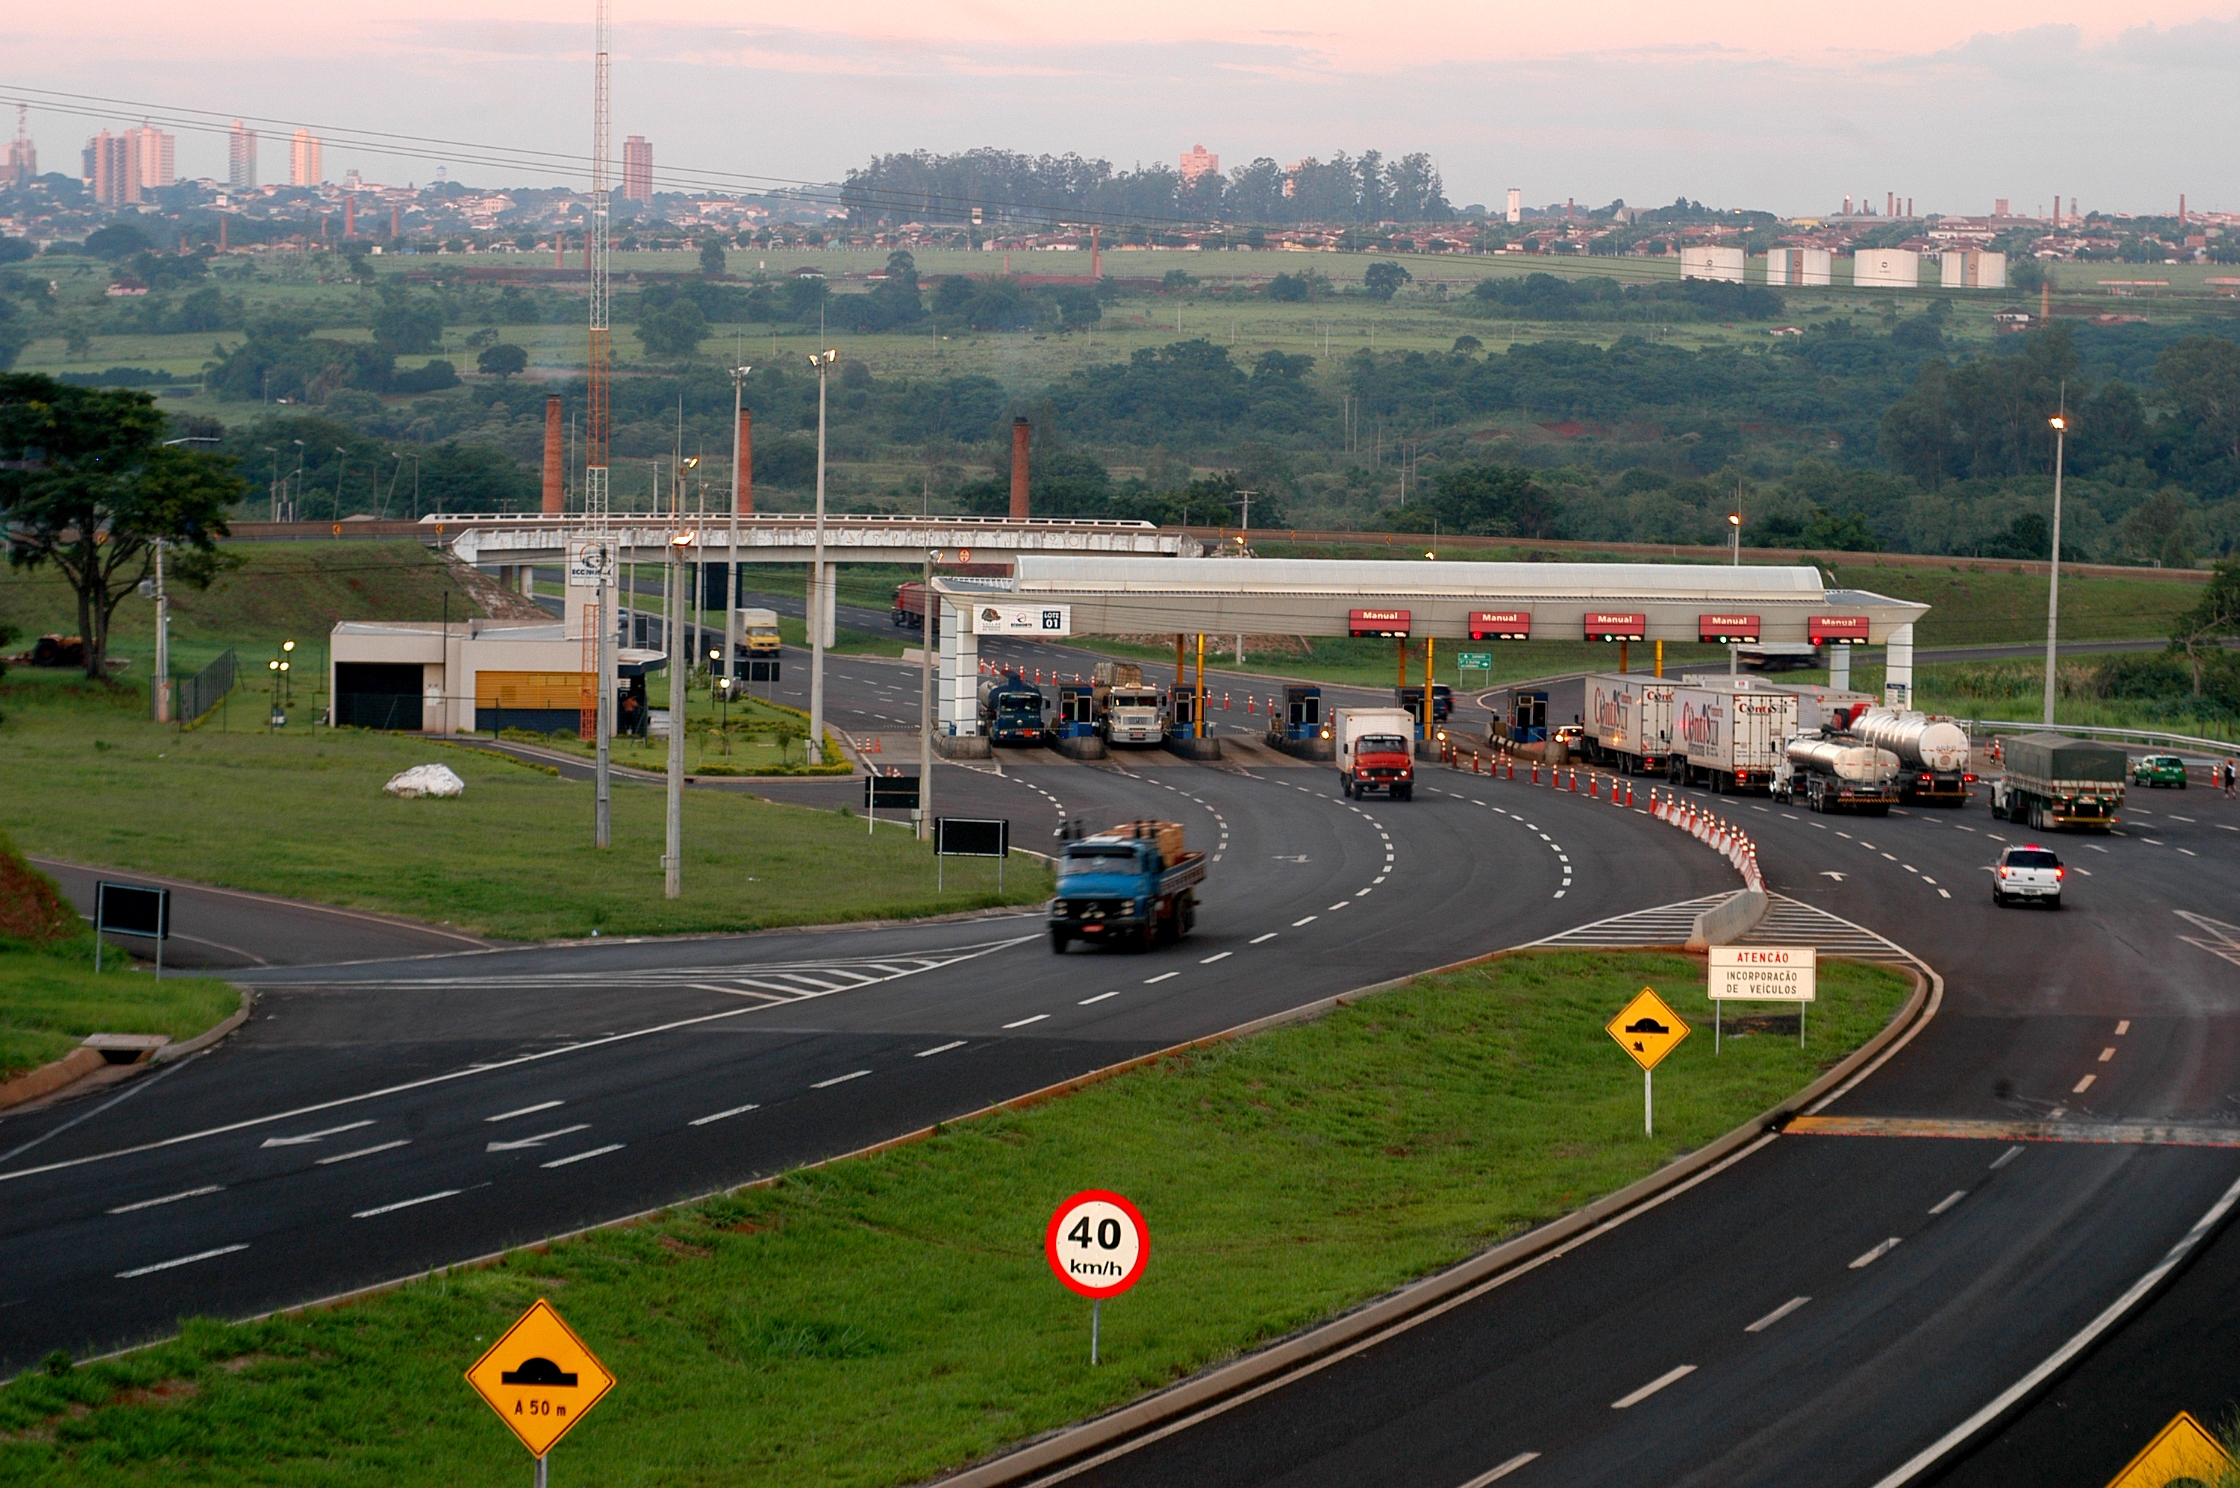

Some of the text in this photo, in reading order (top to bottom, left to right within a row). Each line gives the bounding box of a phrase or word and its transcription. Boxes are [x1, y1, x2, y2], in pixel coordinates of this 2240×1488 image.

[1363, 611, 1398, 620] Manual
[1482, 613, 1517, 622] Manual
[1598, 615, 1633, 624] Manual
[1046, 620, 1058, 628] 01
[1712, 617, 1747, 625] Manual
[1822, 618, 1856, 627] Manual
[1726, 982, 1797, 995] DE VEÍCULOS
[1067, 1215, 1122, 1250] 40
[1070, 1258, 1122, 1276] km/h
[514, 1400, 567, 1417] A 50 m
